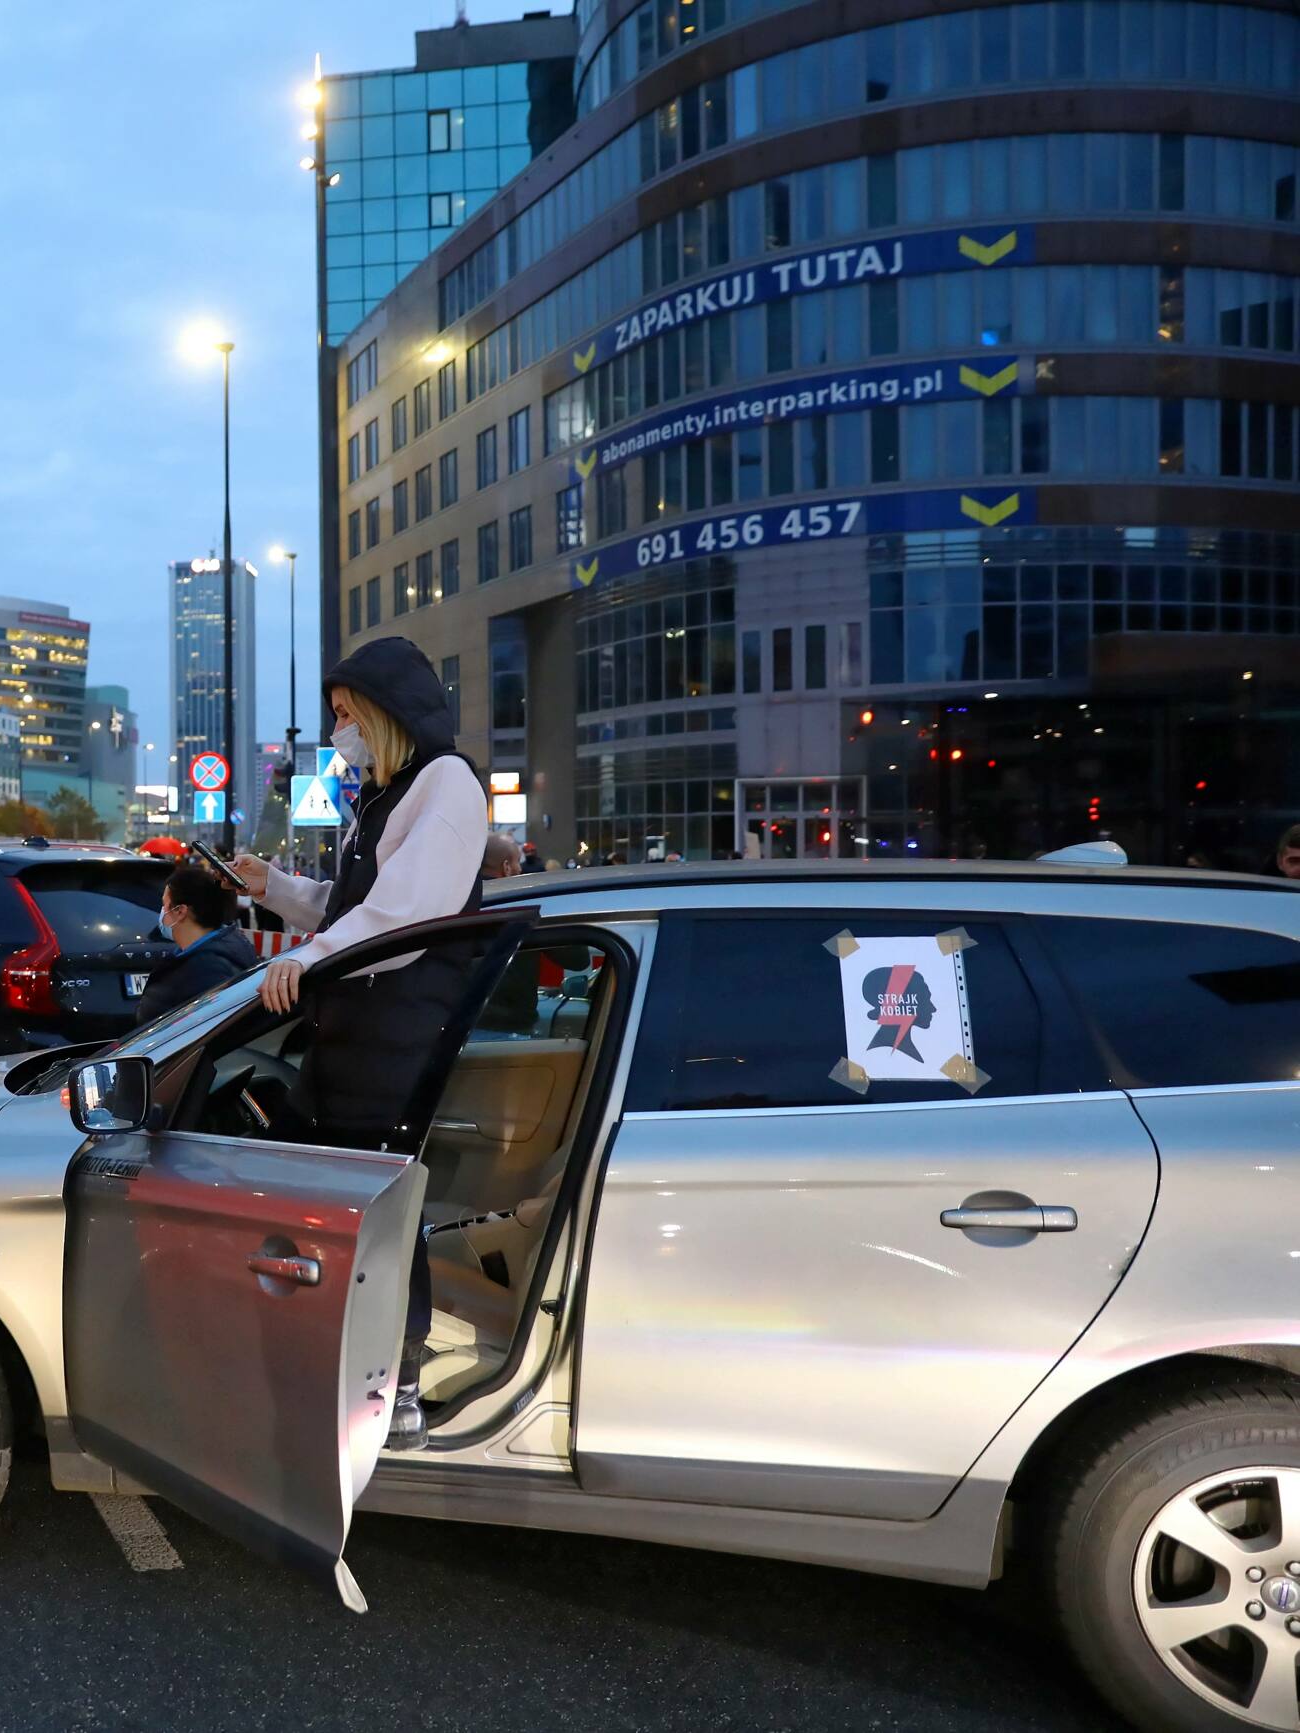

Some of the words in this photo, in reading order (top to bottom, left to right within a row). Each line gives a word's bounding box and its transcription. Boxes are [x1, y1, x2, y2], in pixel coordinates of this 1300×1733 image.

[615, 272, 754, 351] ZAPARKUJ
[772, 241, 903, 293] TUTAJ
[602, 369, 943, 465] abonamenty.interparking.pl
[636, 530, 685, 567] 691
[696, 514, 764, 551] 456
[779, 502, 861, 539] 457
[61, 979, 90, 988] XC90
[878, 993, 918, 1005] STRAJK
[880, 1005, 918, 1017] KOBIET
